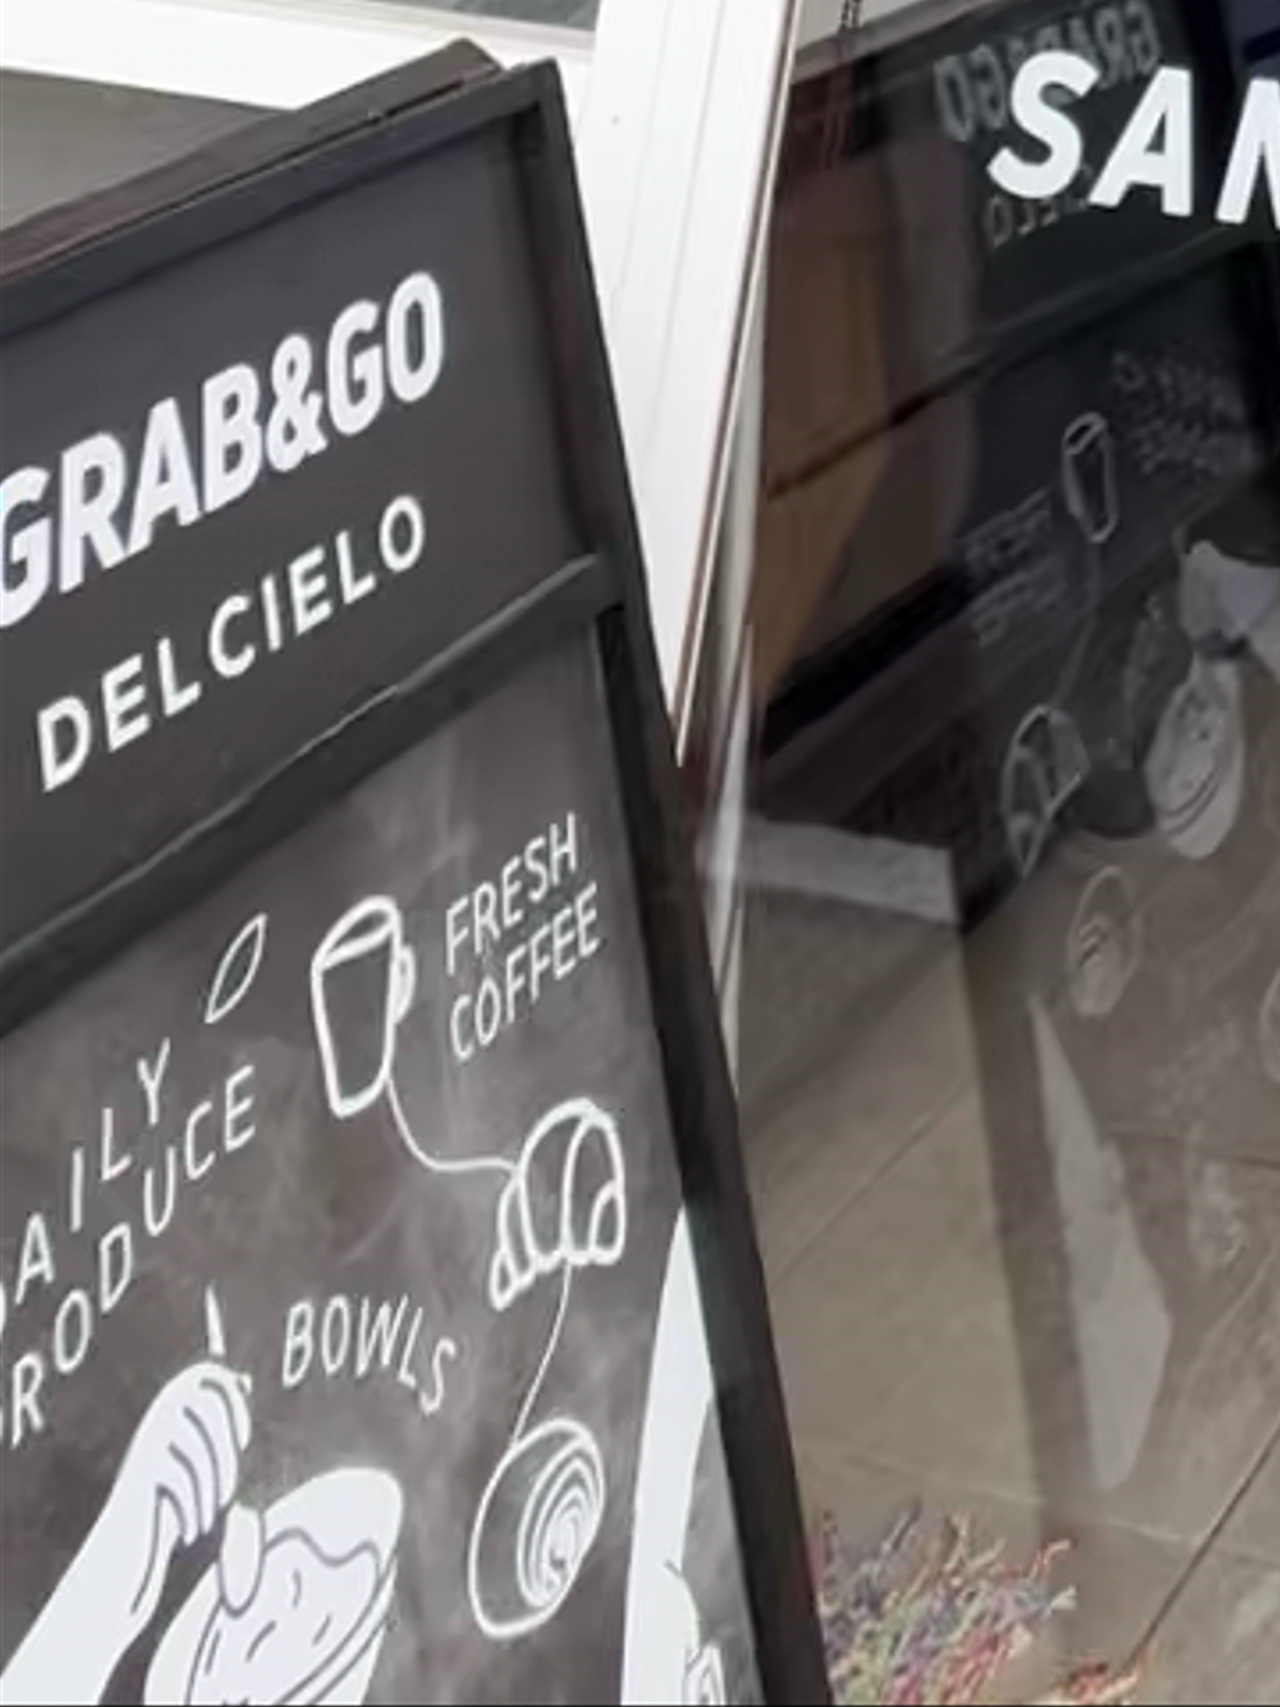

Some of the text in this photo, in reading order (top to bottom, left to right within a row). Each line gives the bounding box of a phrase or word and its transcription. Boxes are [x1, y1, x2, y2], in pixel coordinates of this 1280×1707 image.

[0, 270, 444, 630] GRAB&GO
[446, 812, 578, 978] FRESH
[449, 883, 601, 1065] COFFEE
[0, 1037, 171, 1344] AILY
[0, 1064, 257, 1448] RODUCE
[281, 1293, 457, 1417] BOWLS
